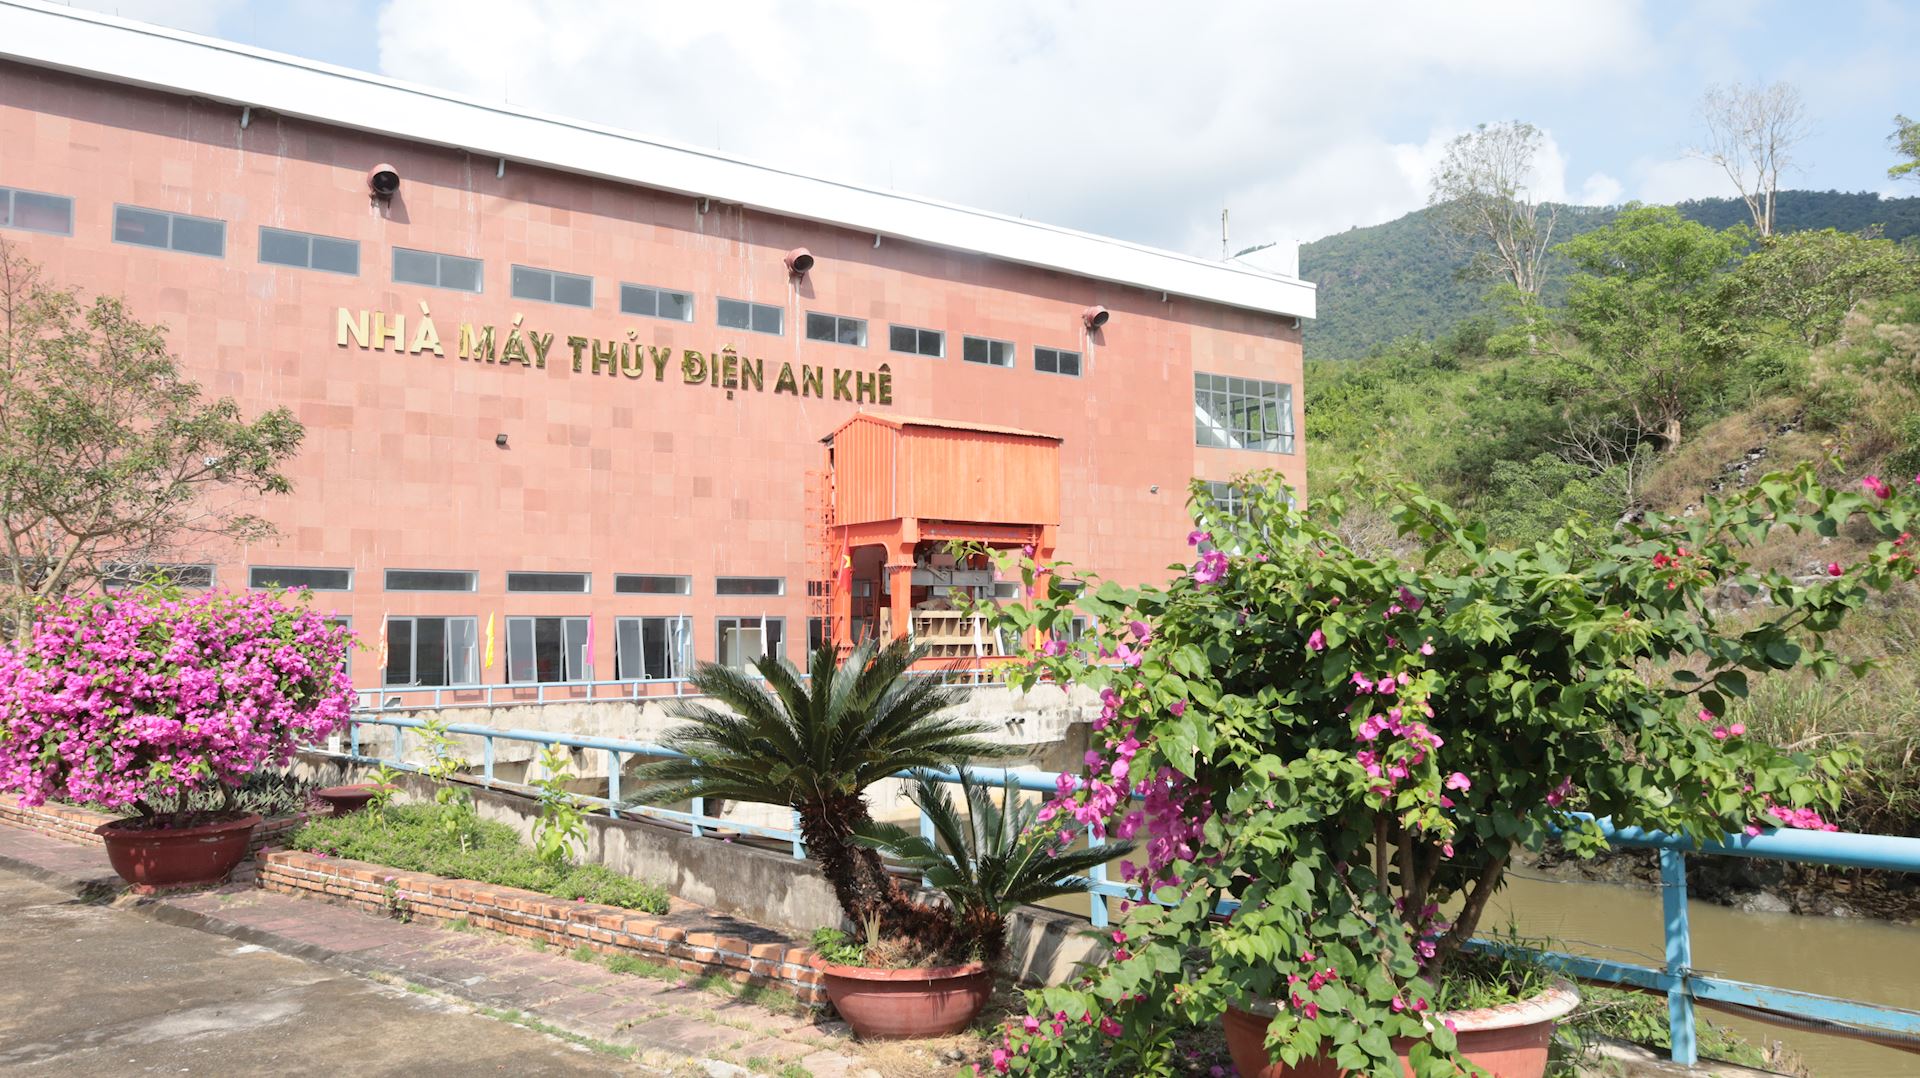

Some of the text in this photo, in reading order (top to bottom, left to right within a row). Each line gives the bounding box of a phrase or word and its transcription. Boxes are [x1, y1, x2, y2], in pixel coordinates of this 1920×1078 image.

[337, 298, 893, 405] NHÀ MÁY THỦY ĐIỆN AN KHÊ
